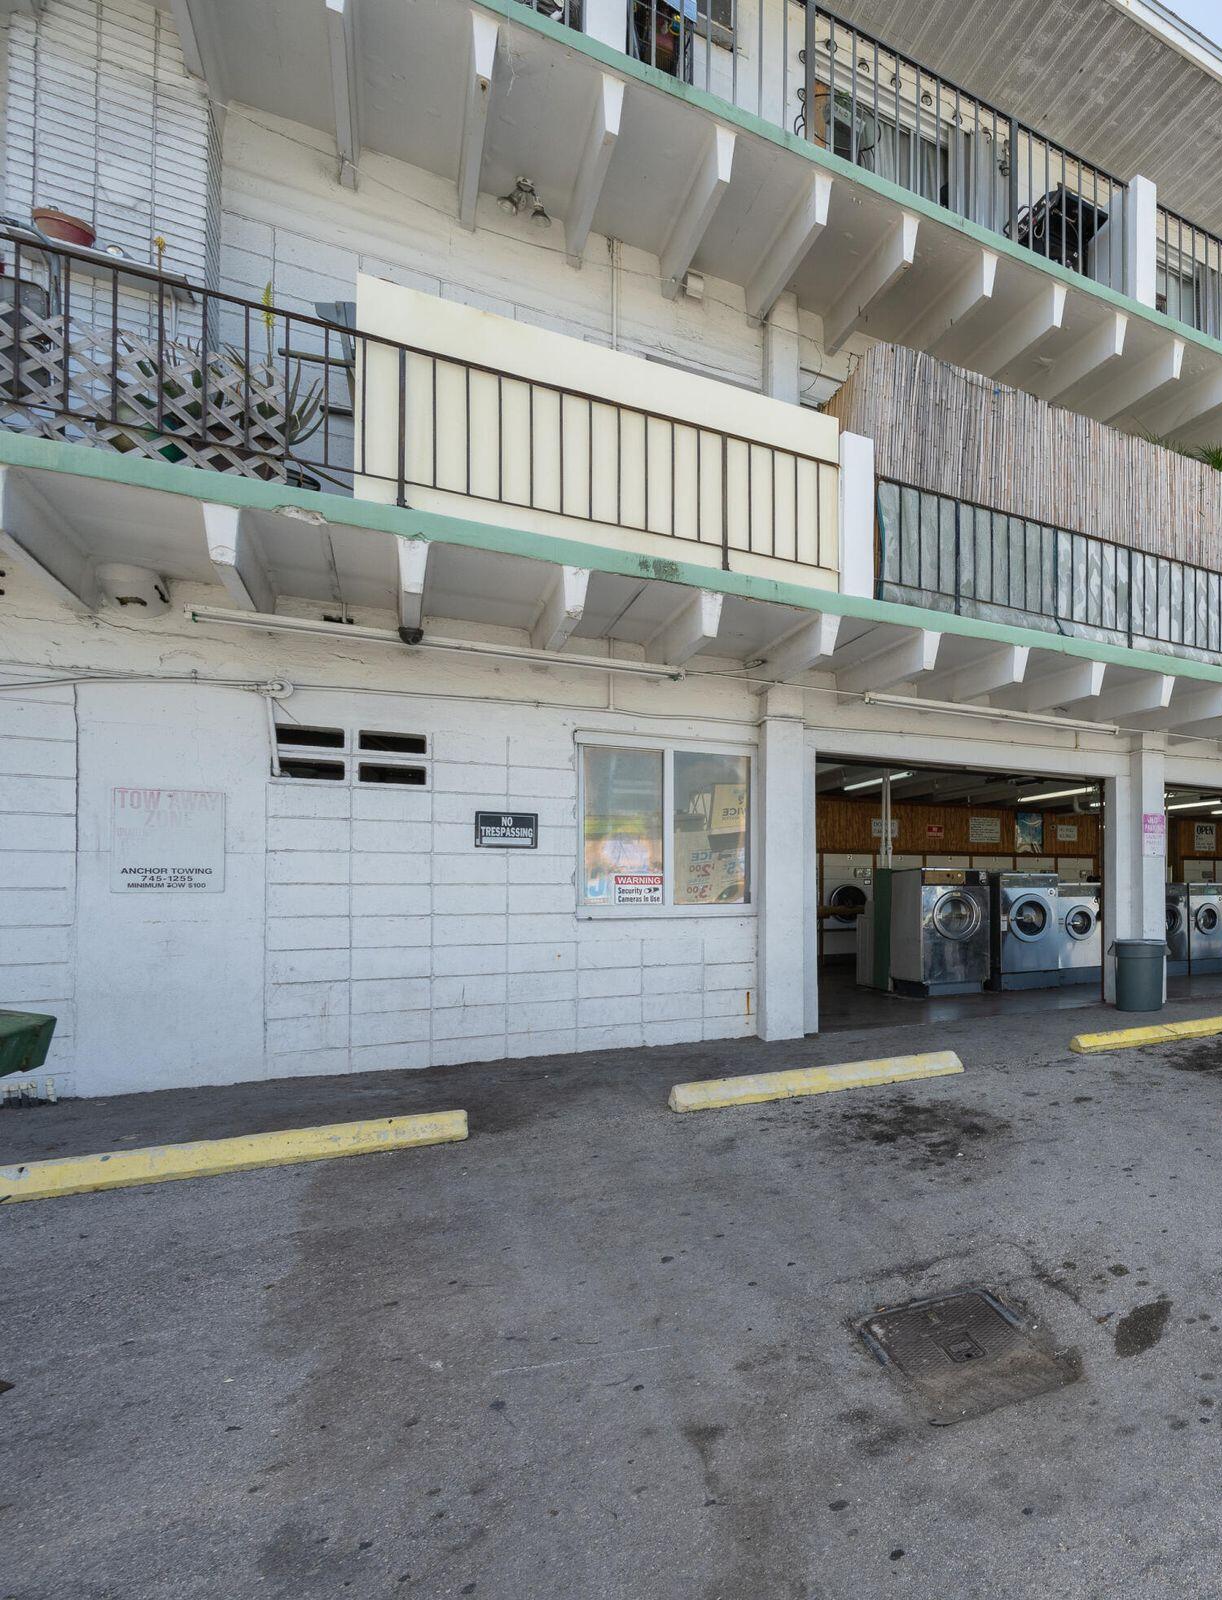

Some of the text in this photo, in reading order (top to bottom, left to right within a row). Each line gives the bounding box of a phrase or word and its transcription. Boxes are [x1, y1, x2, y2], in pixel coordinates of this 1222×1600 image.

[117, 789, 160, 809] TOW
[502, 816, 513, 827] NO
[481, 826, 533, 838] TRESPASSING
[1197, 825, 1214, 835] OPEN
[618, 887, 642, 895] Security
